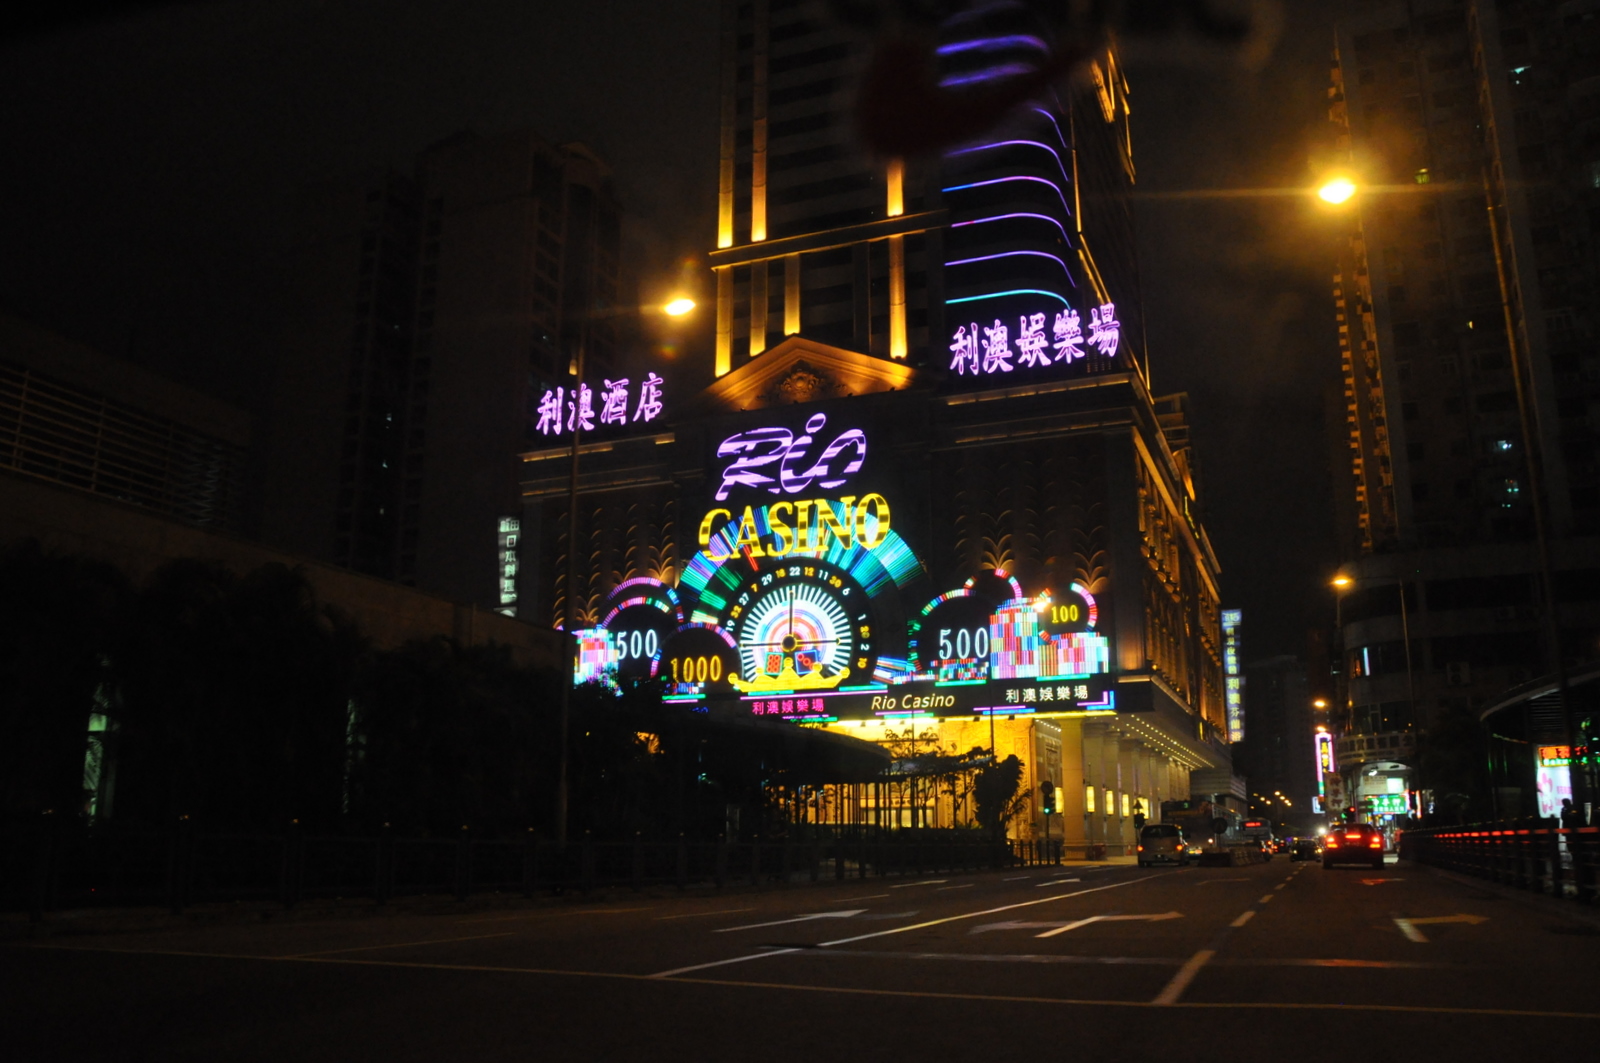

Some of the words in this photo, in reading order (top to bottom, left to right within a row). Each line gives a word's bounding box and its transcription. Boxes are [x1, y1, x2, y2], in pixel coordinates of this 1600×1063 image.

[536, 372, 663, 435] 利澳酒店
[698, 493, 890, 561] CASINO
[725, 620, 735, 632] 19
[739, 593, 750, 606] 27
[751, 584, 758, 592] 7
[761, 574, 772, 586] 29
[789, 567, 800, 576] 22
[804, 567, 814, 576] 12
[818, 570, 829, 581] 11
[842, 587, 850, 595] 6
[1051, 605, 1078, 624] 100
[617, 629, 657, 660] 500
[939, 627, 989, 660] 500
[671, 655, 721, 683] 1000
[871, 695, 896, 710] Rio
[901, 693, 955, 709] Casino
